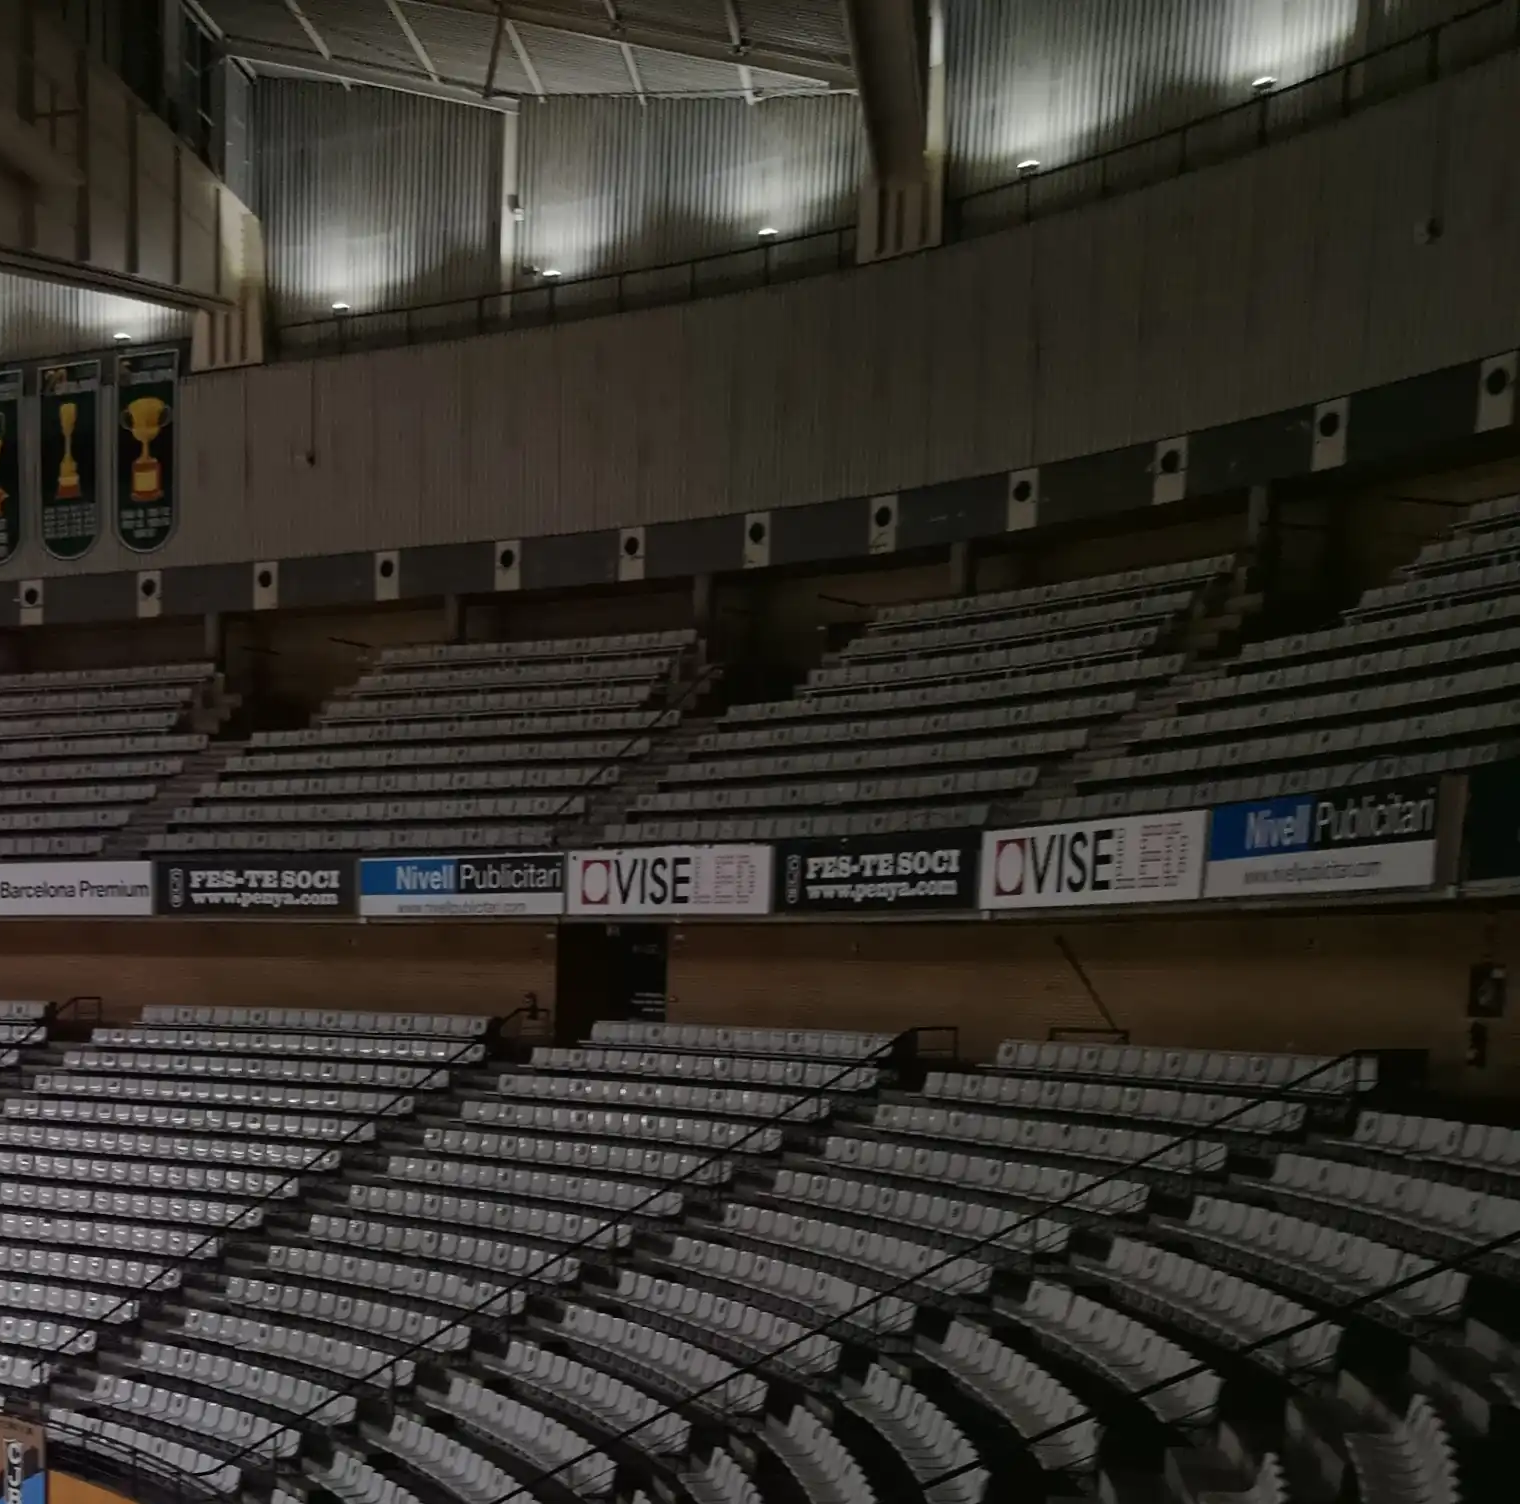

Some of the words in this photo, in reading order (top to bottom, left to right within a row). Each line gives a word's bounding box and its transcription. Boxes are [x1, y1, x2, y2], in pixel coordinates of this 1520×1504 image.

[1243, 804, 1311, 852] Nivell
[1312, 786, 1438, 845] Publicitari
[895, 850, 961, 874] SOCI
[189, 869, 279, 889] FES-TE
[280, 868, 341, 888] SOCI
[394, 864, 455, 891] Nivell
[458, 861, 562, 891] Publicitari
[0, 880, 76, 899] Barcelona
[80, 878, 150, 898] Premium
